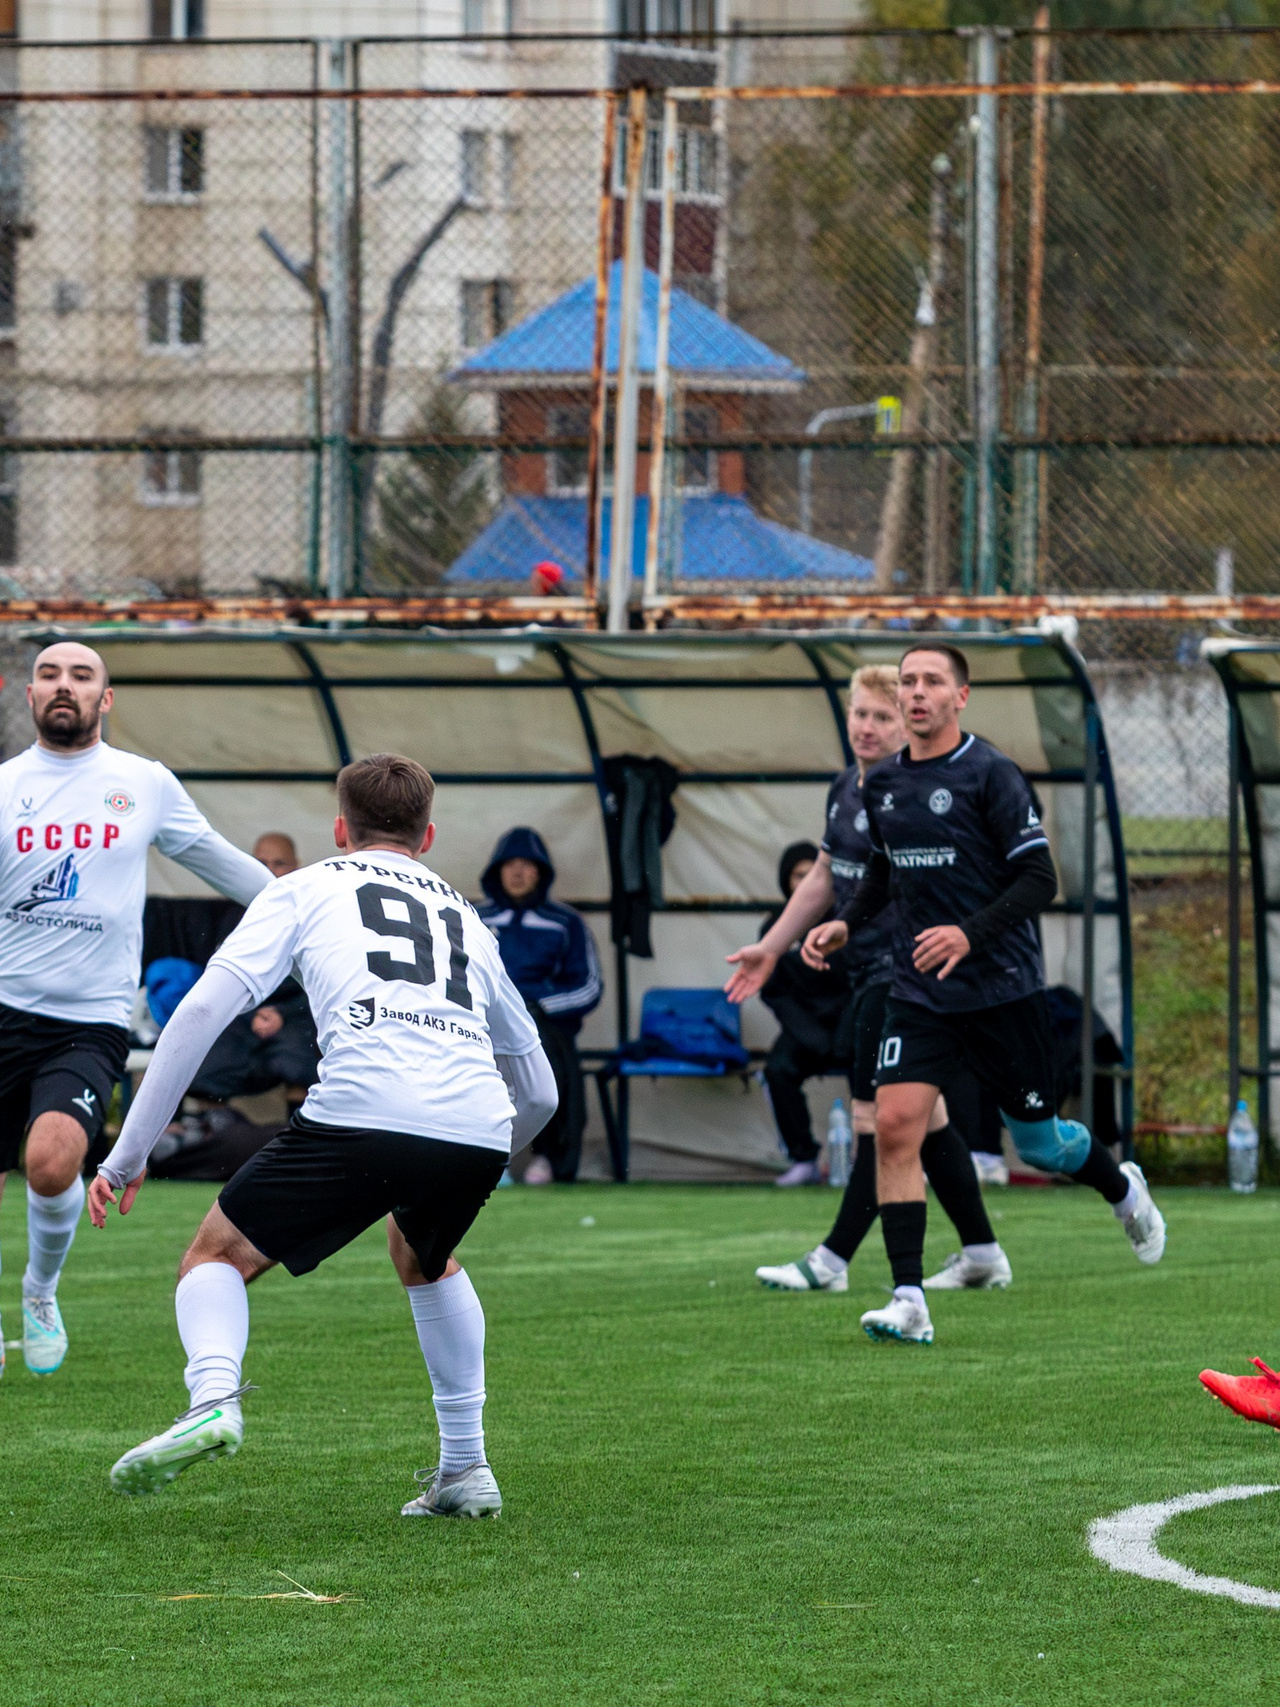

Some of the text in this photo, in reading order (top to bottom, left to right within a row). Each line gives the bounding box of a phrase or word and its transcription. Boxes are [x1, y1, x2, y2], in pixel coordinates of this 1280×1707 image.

[17, 822, 120, 853] СССР
[355, 882, 473, 1011] 91
[380, 1006, 420, 1027] Завод
[423, 1014, 447, 1032] АКЗ
